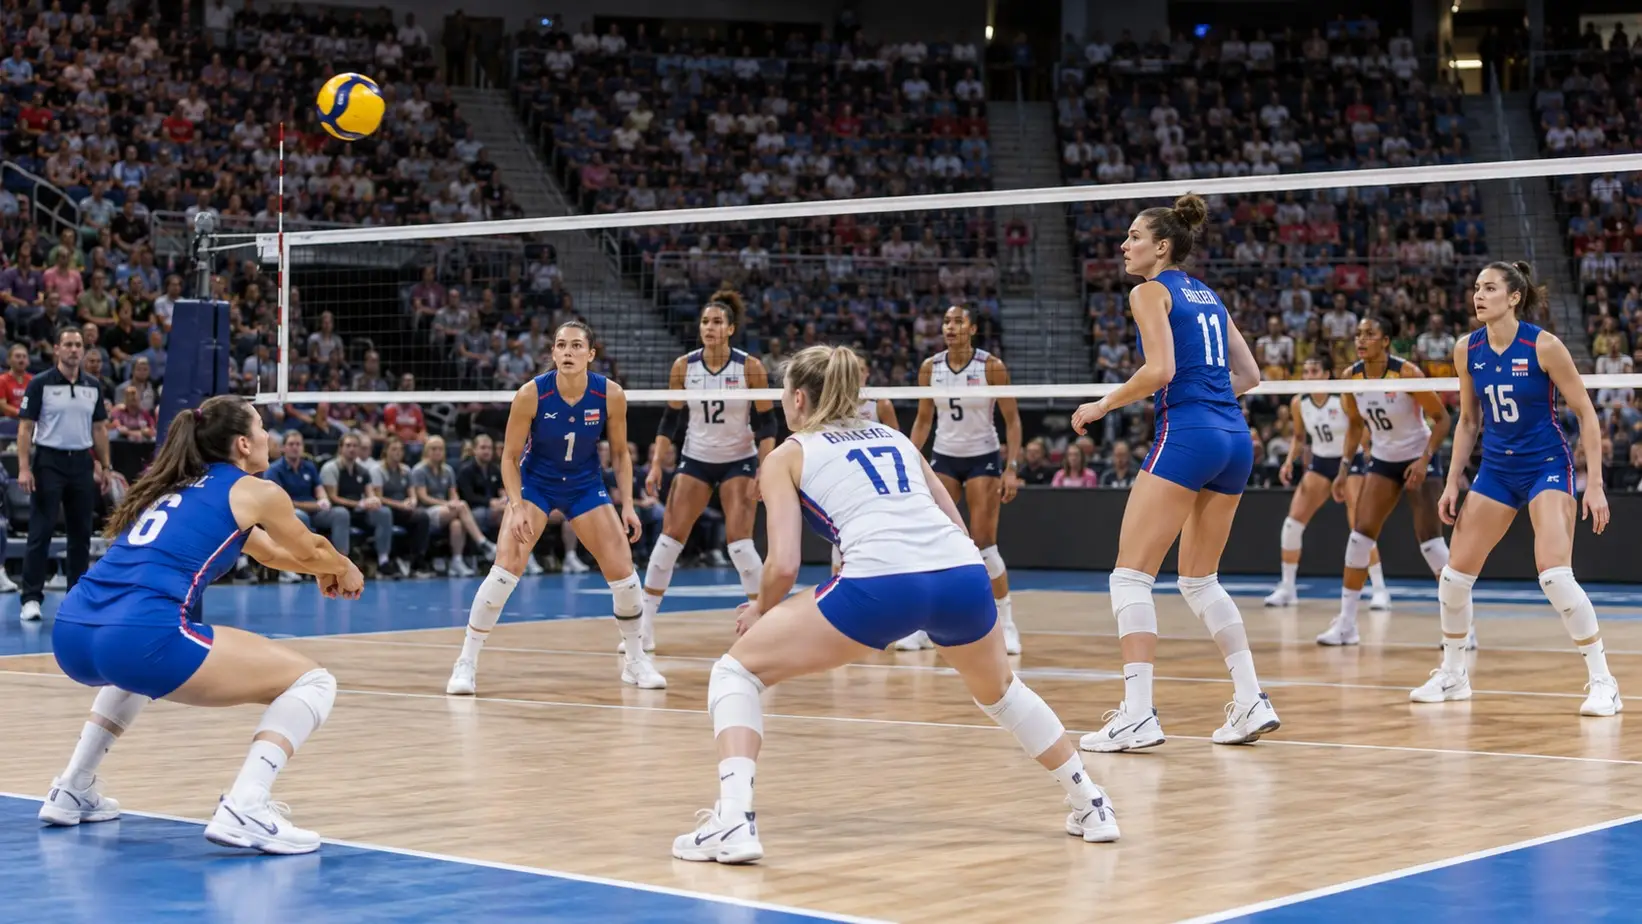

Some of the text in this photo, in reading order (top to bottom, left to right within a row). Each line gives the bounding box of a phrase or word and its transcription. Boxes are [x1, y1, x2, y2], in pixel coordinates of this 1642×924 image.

[1197, 312, 1225, 367] 11
[701, 400, 725, 424] 12
[949, 398, 963, 421] 5
[1484, 384, 1519, 423] 15
[1314, 424, 1334, 443] 16
[1366, 408, 1393, 431] 16
[564, 431, 575, 461] 1
[846, 446, 911, 495] 17
[127, 493, 182, 546] 6
